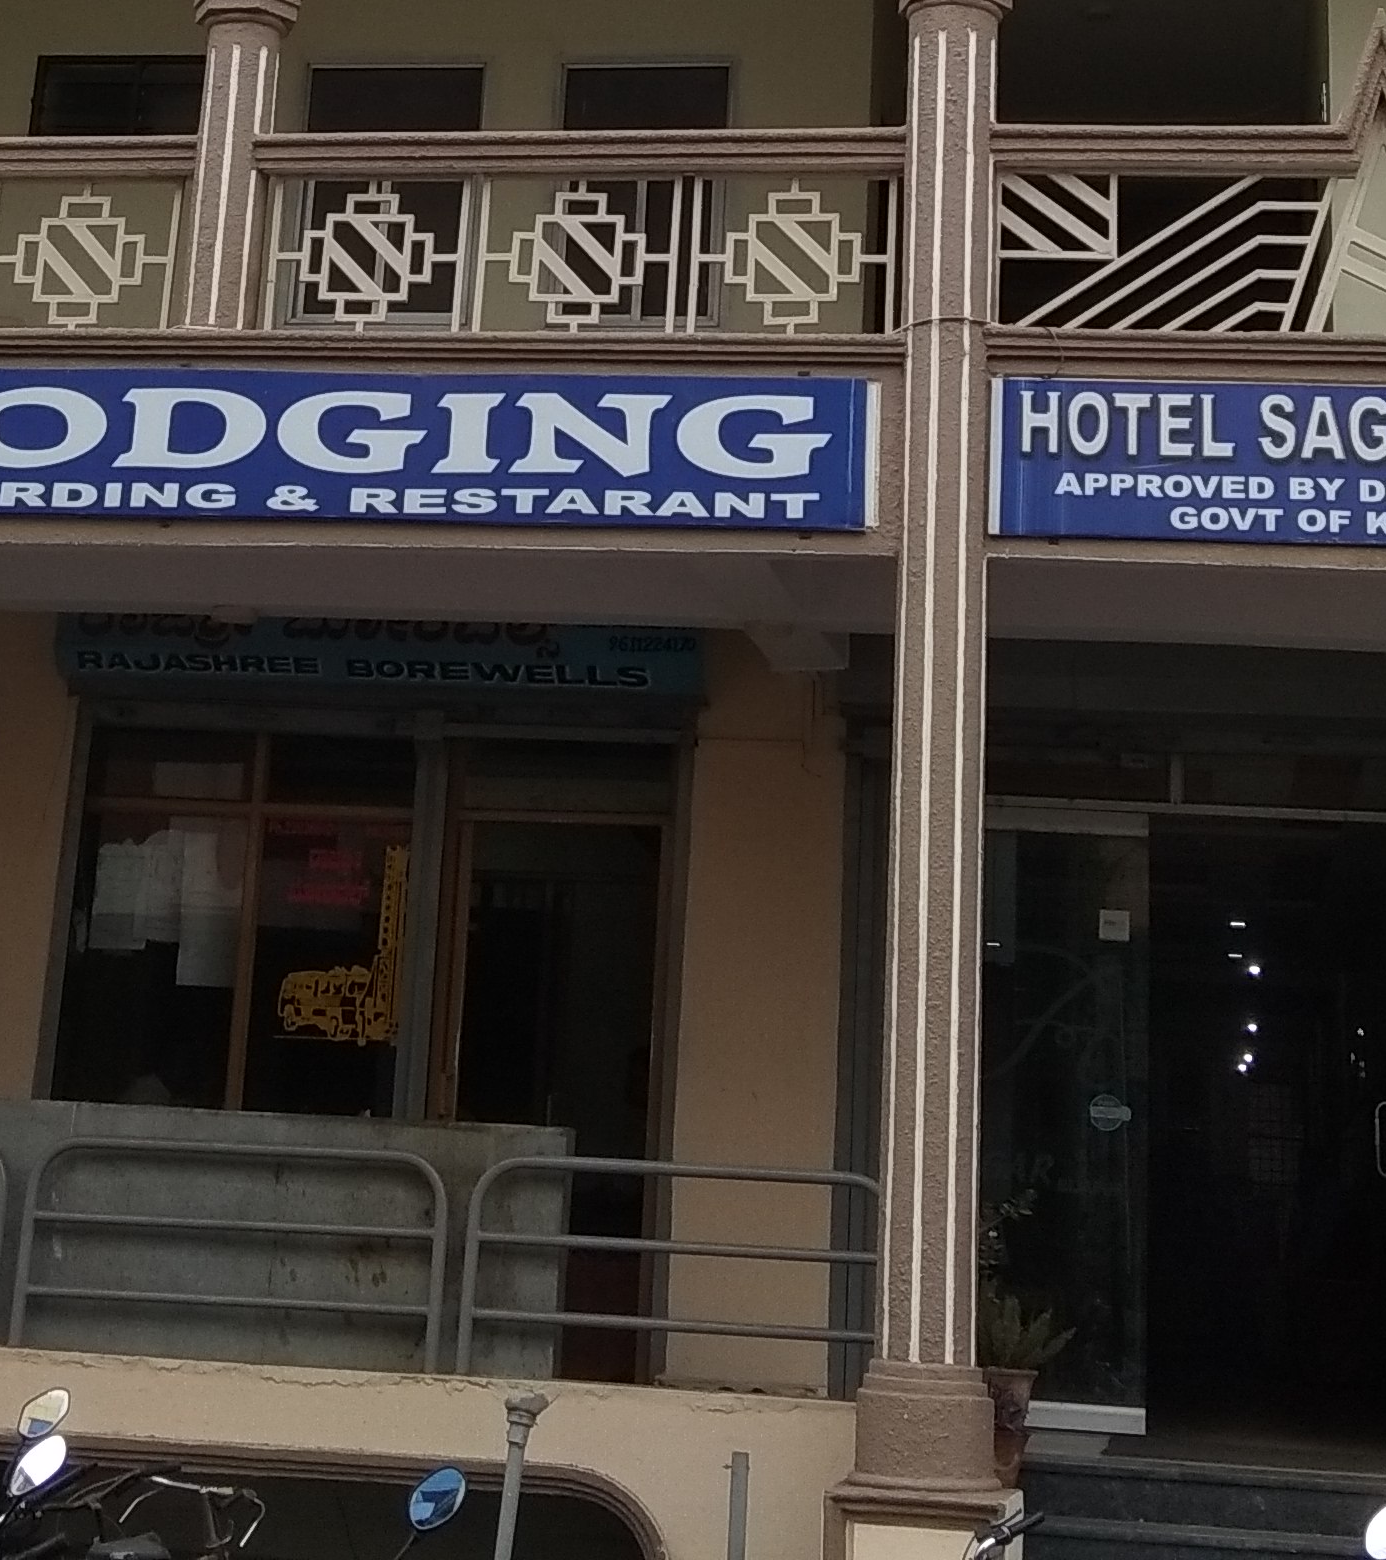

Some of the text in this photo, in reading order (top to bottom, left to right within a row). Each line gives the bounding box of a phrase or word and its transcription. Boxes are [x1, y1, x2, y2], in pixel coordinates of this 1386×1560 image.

[1019, 390, 1237, 458] HOTEL
[266, 485, 320, 512] &
[349, 487, 820, 519] RESTARANT
[1054, 472, 1275, 500] APPROVED
[1289, 477, 1346, 501] BY
[1170, 506, 1284, 532] GOVT
[1297, 509, 1352, 533] OF
[76, 650, 650, 688] RAJASHREE BOREWELLS
